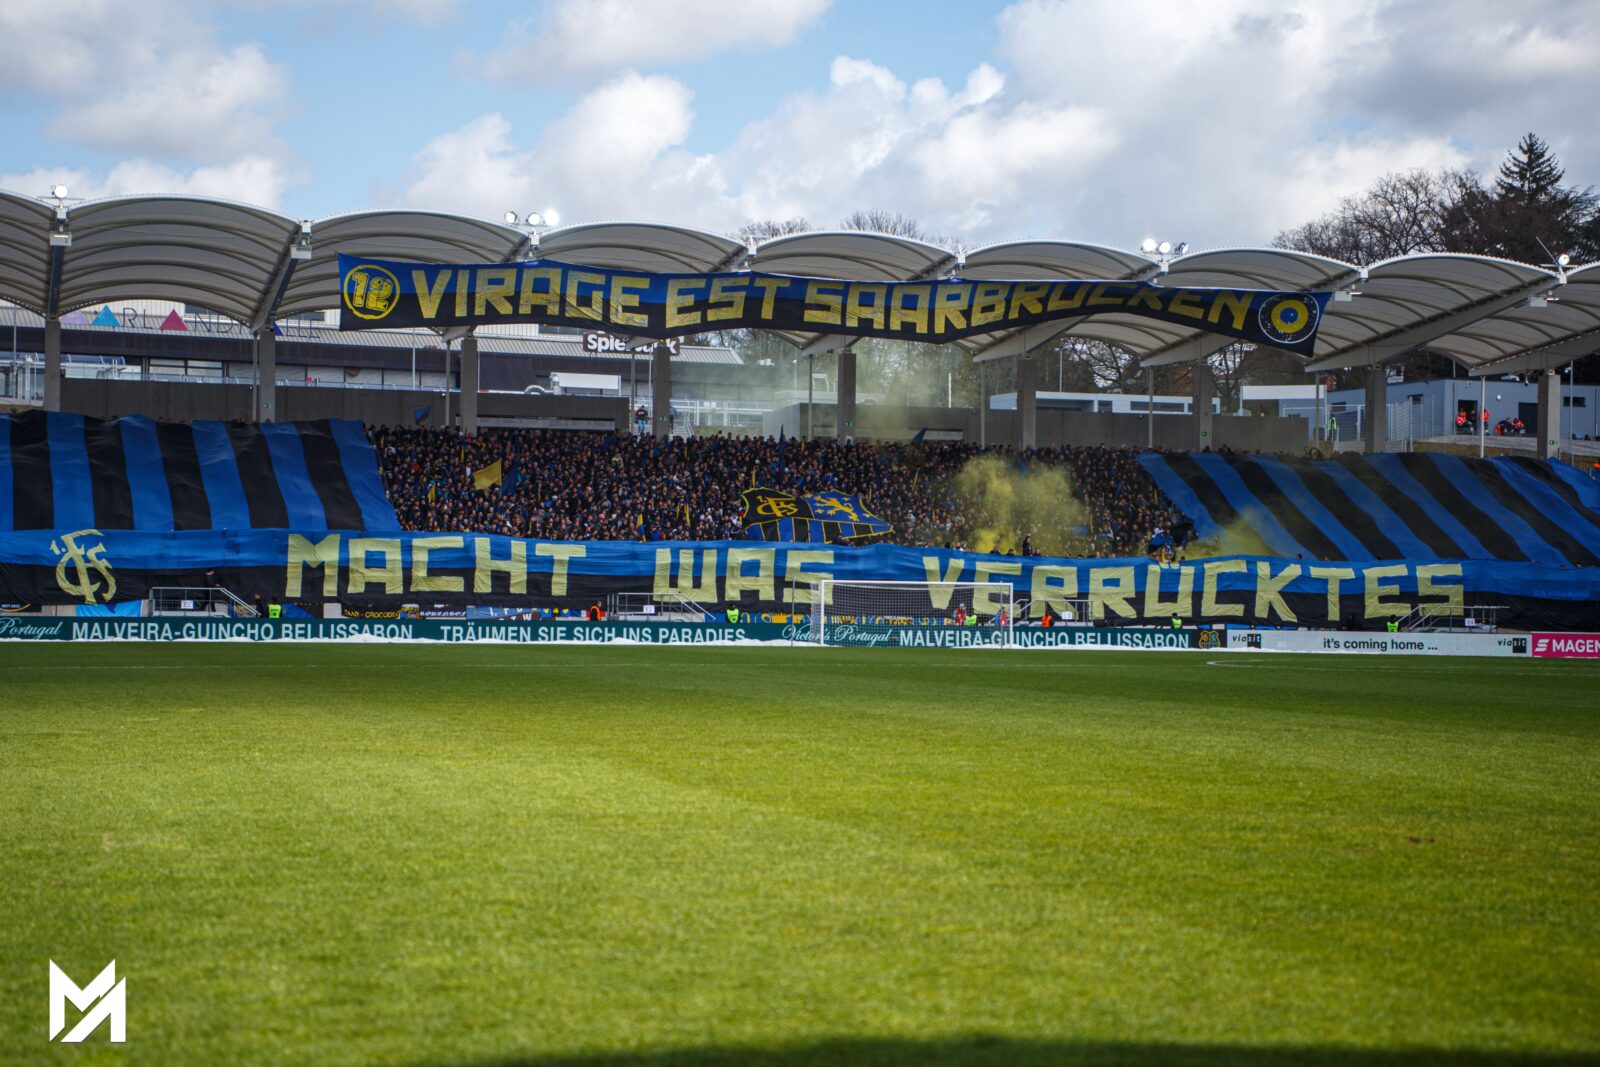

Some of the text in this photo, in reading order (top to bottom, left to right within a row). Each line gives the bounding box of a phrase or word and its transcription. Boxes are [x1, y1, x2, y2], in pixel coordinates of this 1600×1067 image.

[411, 269, 649, 327] VIRAGE
[666, 277, 791, 328] EST
[285, 533, 587, 598] MACHT
[653, 547, 835, 606] WAS
[0, 617, 63, 640] Portugal
[72, 621, 274, 641] MALVEIRA-GUINCHO
[440, 621, 746, 644] TRÄUMEN SIE SICH INS PARADIES
[834, 625, 893, 647] Portugal
[899, 629, 1069, 647] MALVEIRA-GUINCHO
[1323, 637, 1340, 649] it's
[1343, 638, 1388, 652] coming
[1391, 639, 1425, 650] home
